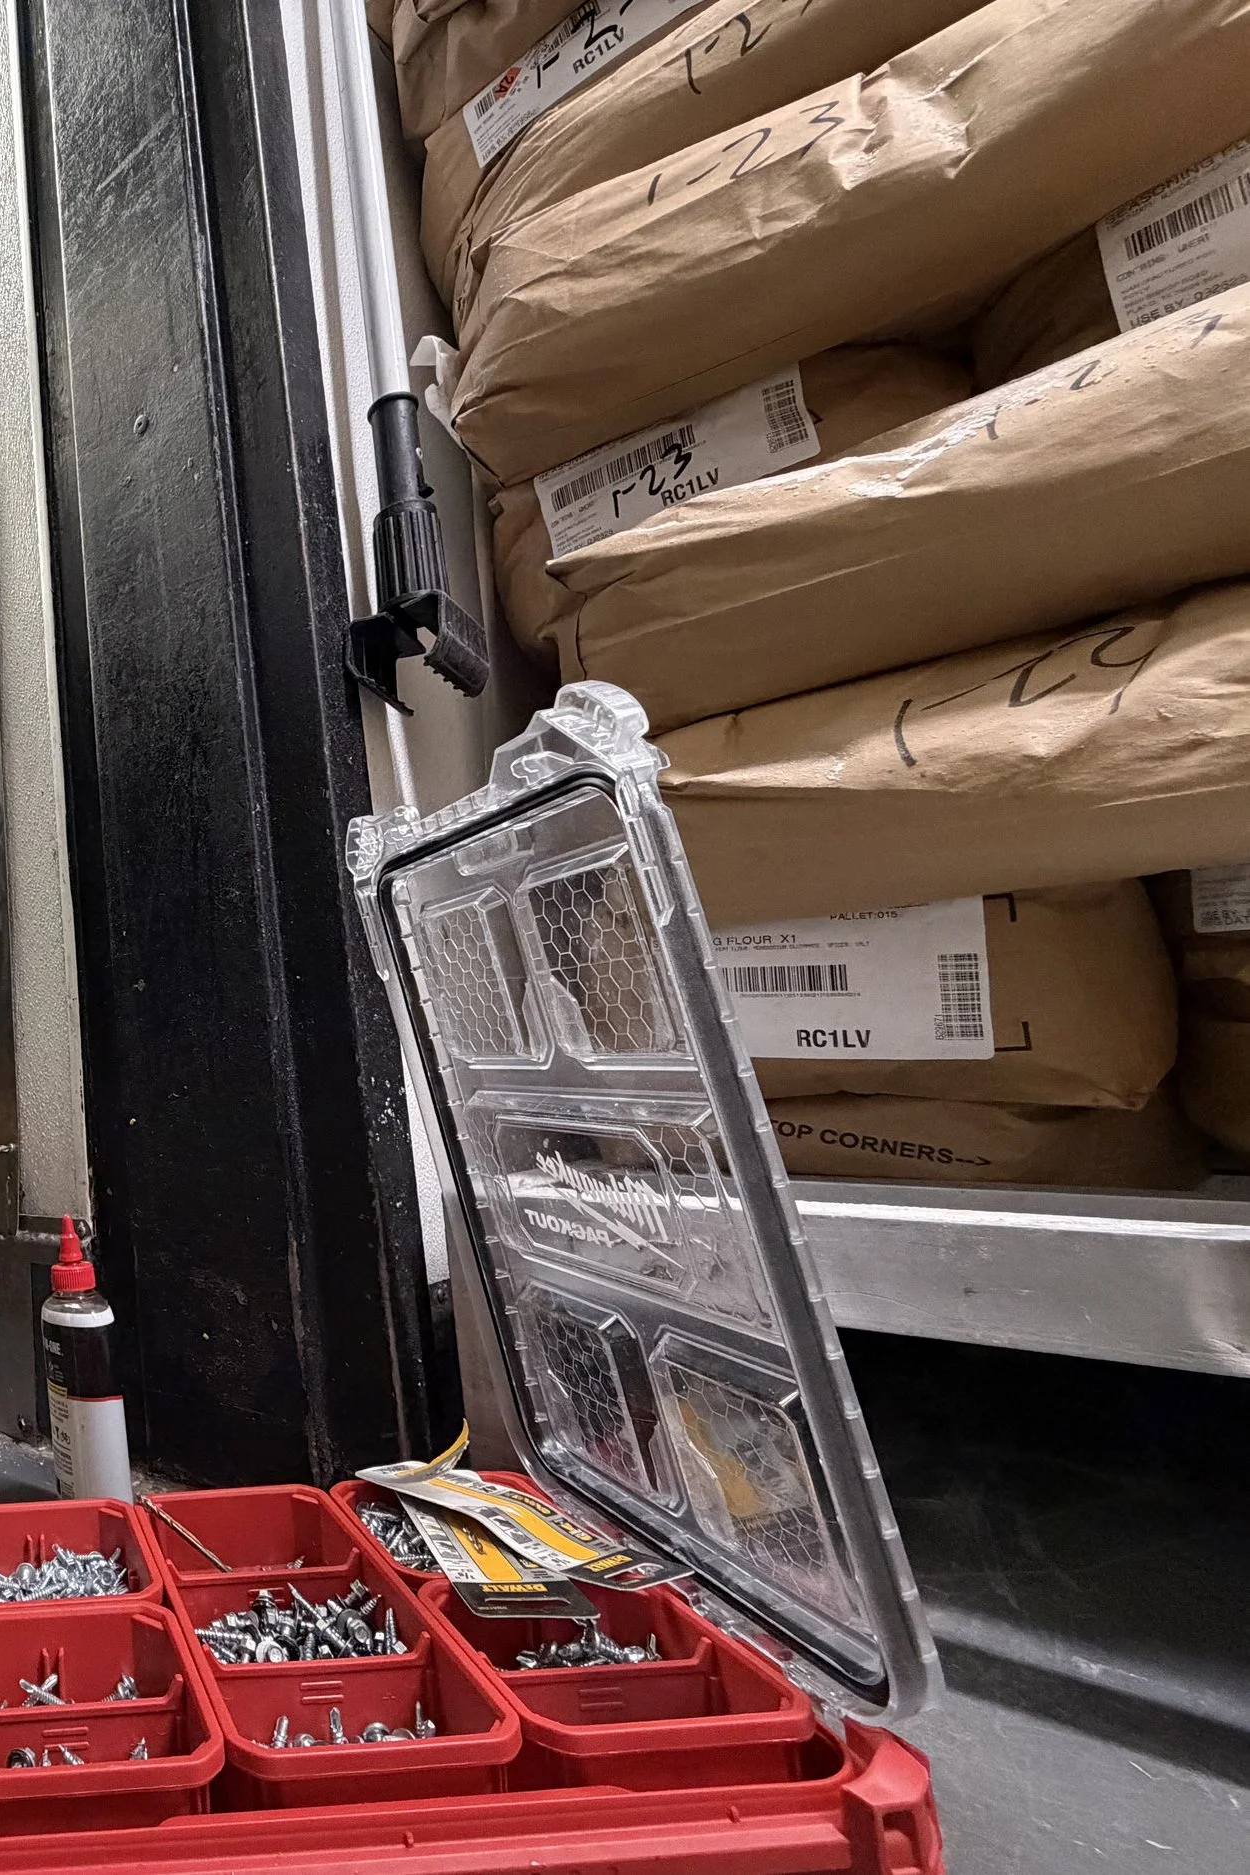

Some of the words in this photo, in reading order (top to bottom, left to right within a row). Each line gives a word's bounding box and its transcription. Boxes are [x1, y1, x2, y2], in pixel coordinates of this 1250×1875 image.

[572, 26, 626, 74] RC1LV
[647, 100, 845, 206] 1-23
[1130, 308, 1160, 329] USE
[1163, 299, 1184, 313] BY
[612, 443, 692, 519] 1-23
[660, 467, 720, 507] RC1LV
[726, 935, 772, 946] FLOUR
[780, 934, 797, 944] X1
[796, 1029, 871, 1048] RC1LV
[482, 1583, 548, 1594] DEWALT
